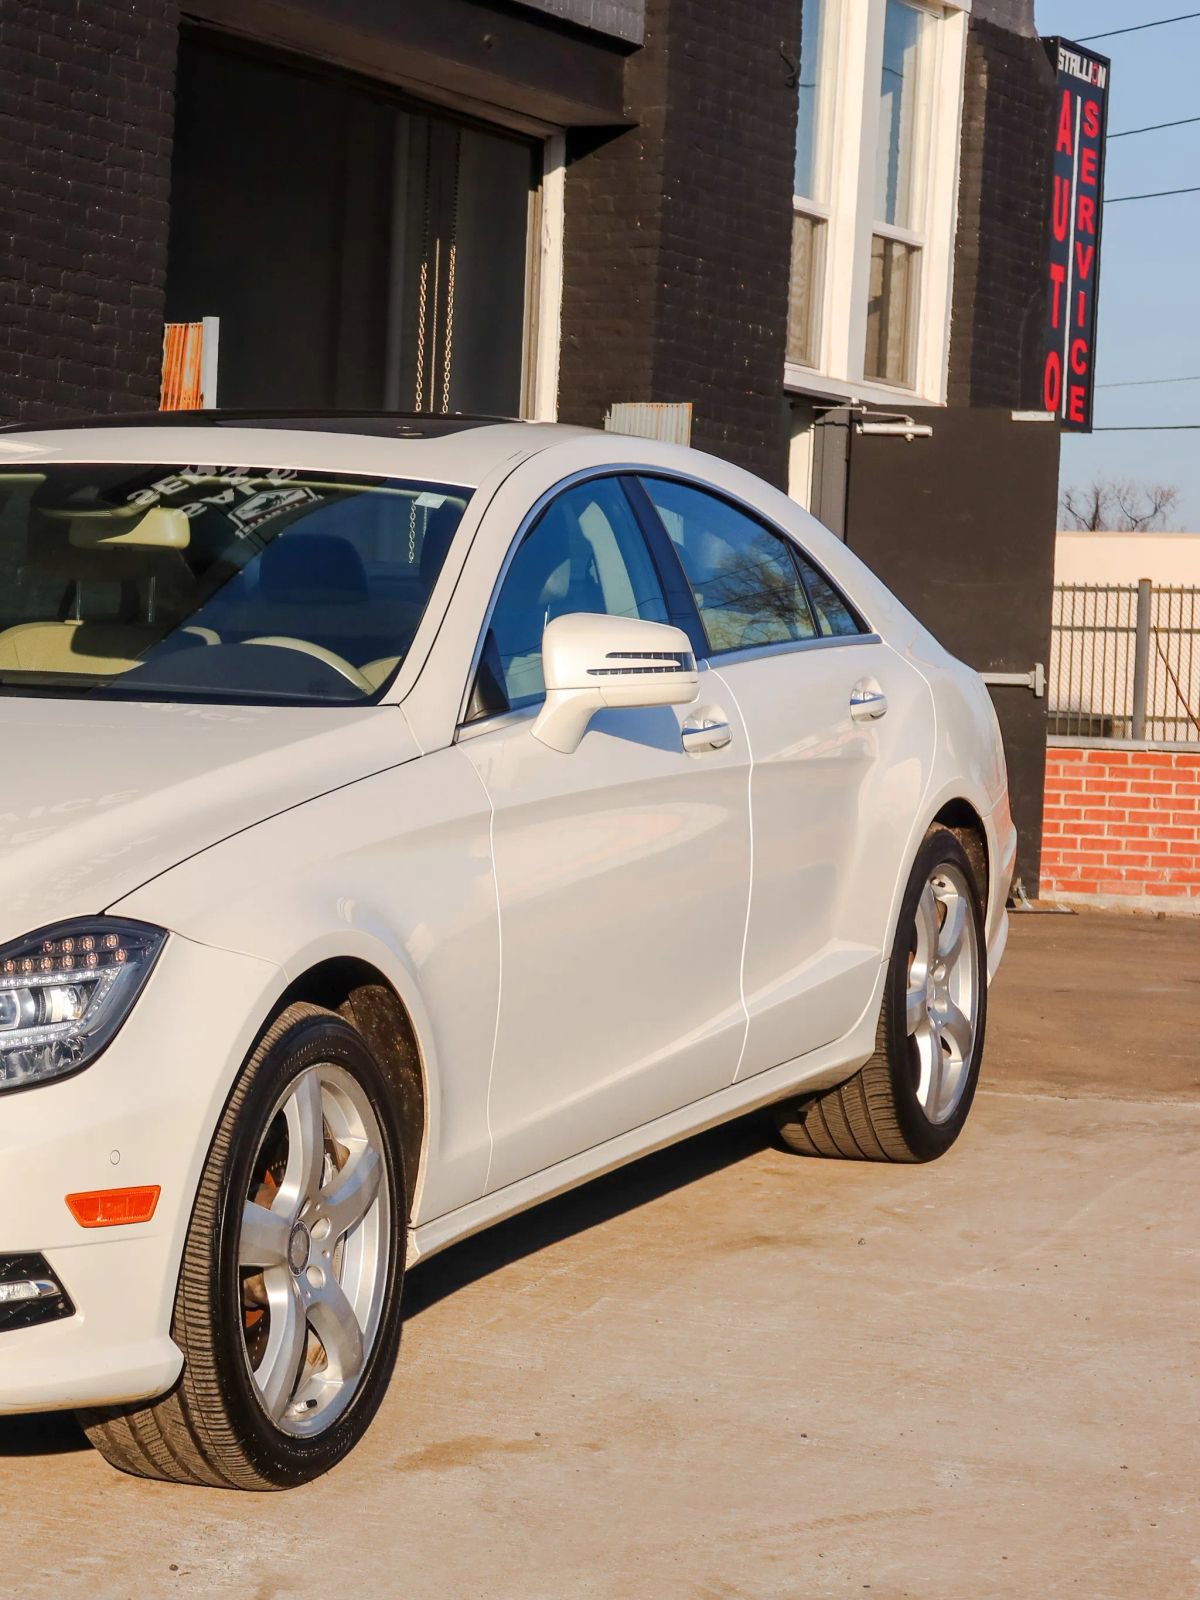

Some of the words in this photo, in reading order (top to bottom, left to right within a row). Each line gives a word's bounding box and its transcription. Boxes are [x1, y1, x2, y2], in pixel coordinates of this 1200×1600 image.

[1058, 47, 1106, 89] STALLION
[1044, 89, 1072, 411] AUTO
[1070, 100, 1099, 423] SERVICE
